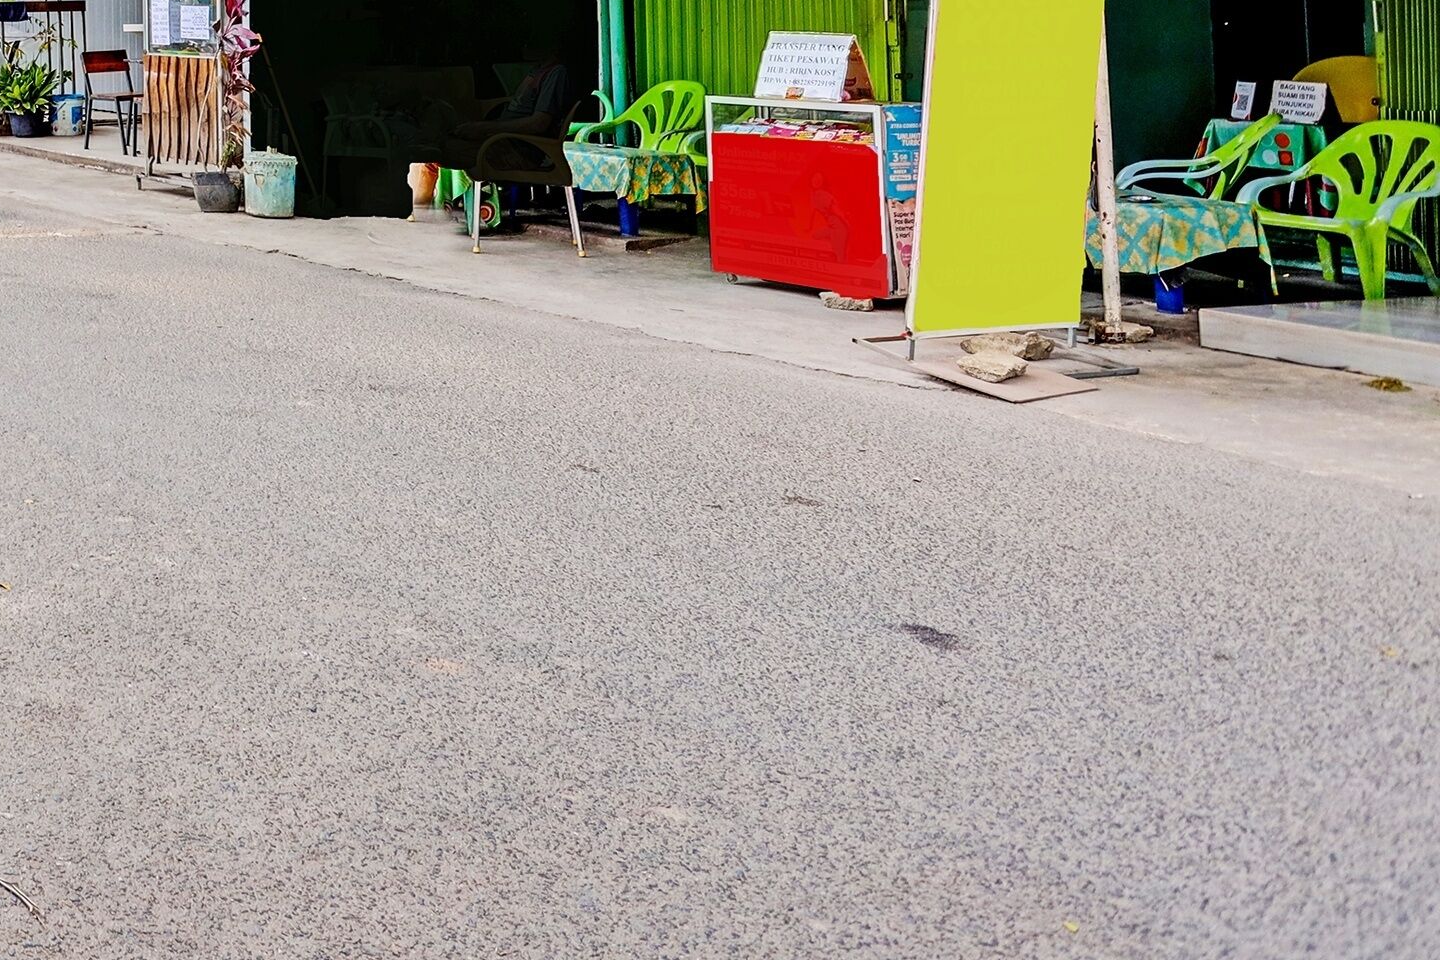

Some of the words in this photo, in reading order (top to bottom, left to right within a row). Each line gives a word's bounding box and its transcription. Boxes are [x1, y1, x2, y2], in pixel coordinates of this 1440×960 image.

[770, 42, 817, 51] TRANSFER
[818, 44, 845, 52] UANG
[768, 54, 795, 62] TIKET
[797, 55, 840, 64] PESAWAT
[789, 67, 812, 75] RIRIN
[1277, 100, 1314, 108] TUNJUKKIN
[1295, 109, 1316, 117] NIKAH
